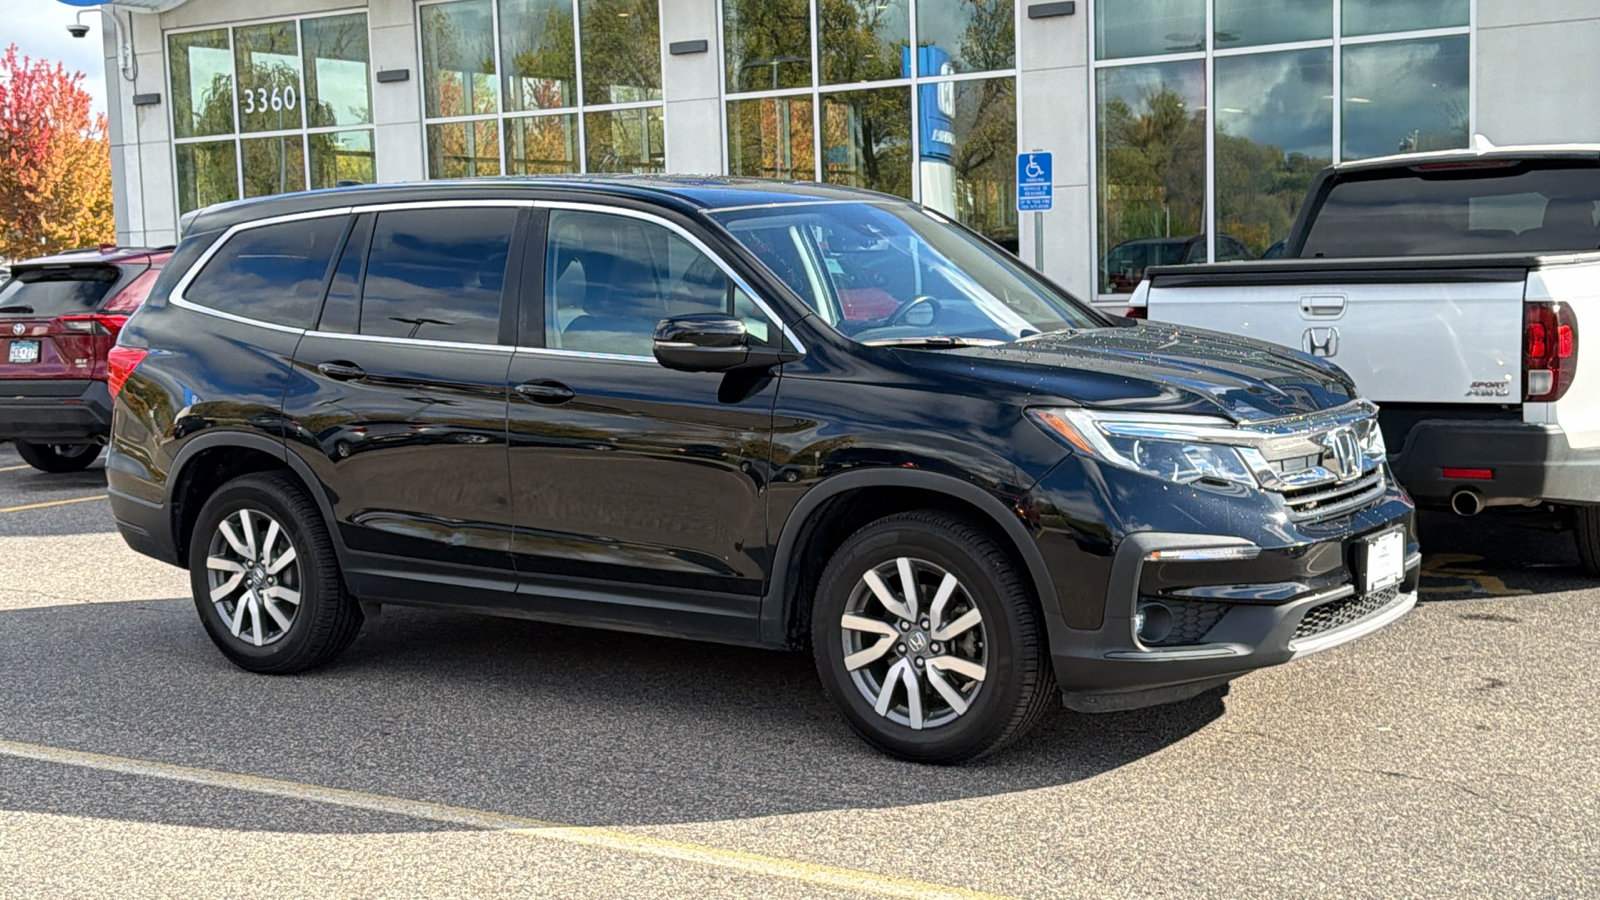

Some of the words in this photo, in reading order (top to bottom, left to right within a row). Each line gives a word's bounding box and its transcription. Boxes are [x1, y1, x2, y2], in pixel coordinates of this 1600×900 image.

[244, 85, 296, 114] 3360
[1470, 381, 1509, 389] SPORT
[1465, 389, 1510, 397] AWD
